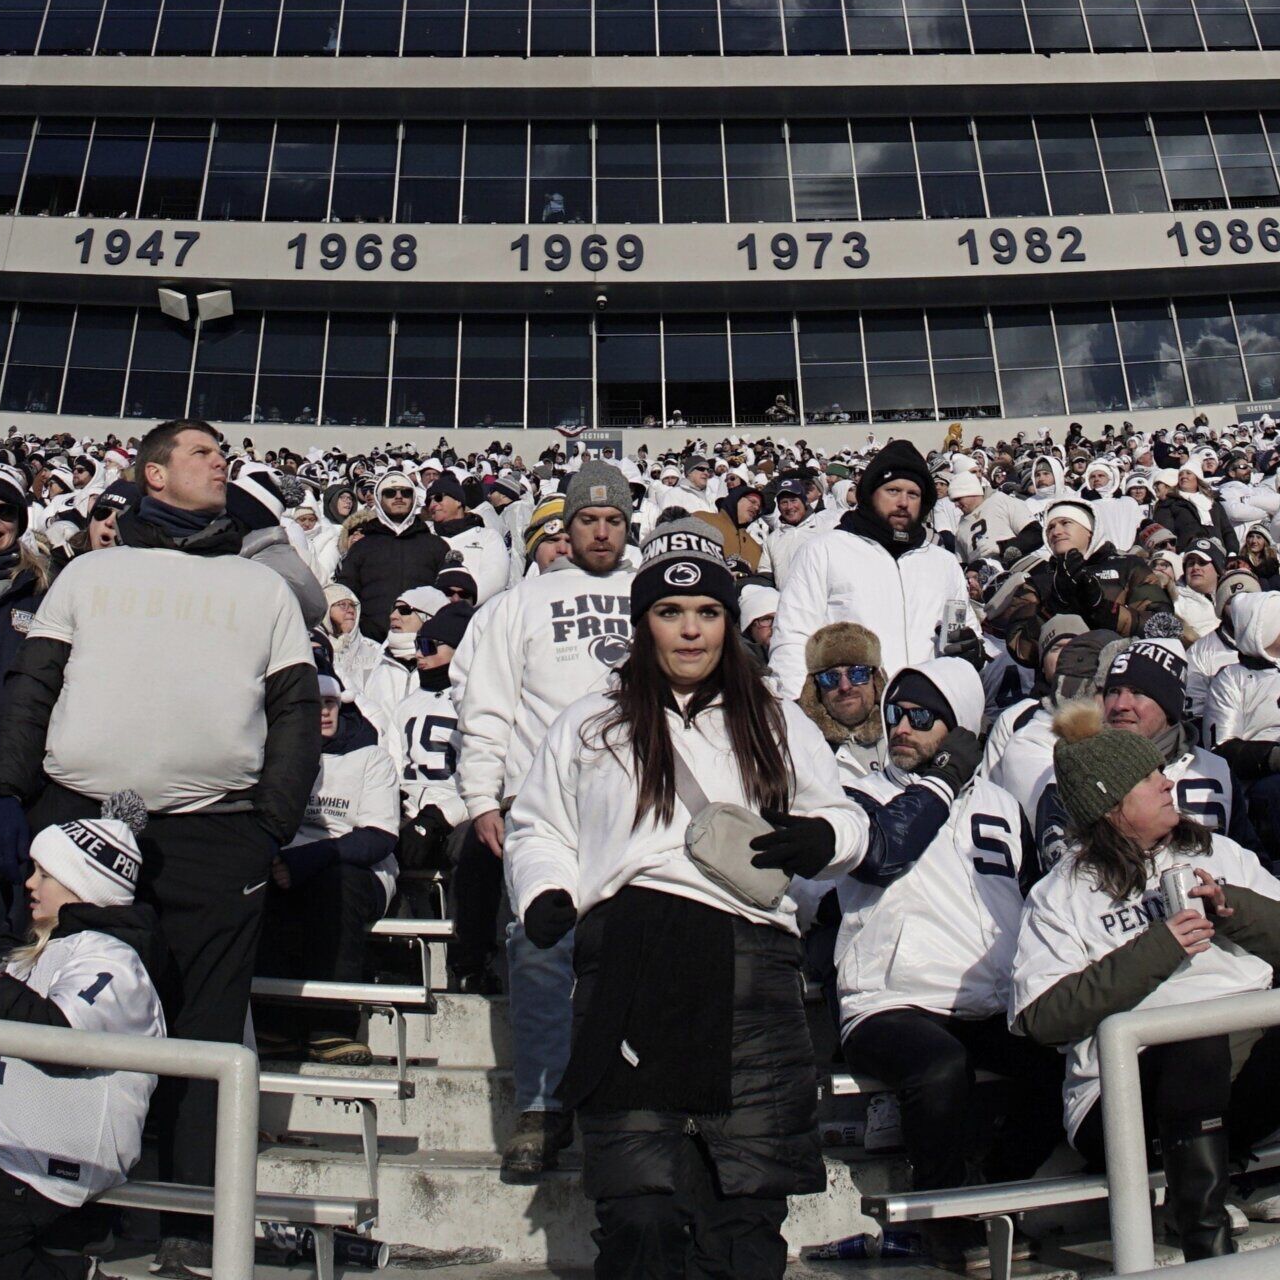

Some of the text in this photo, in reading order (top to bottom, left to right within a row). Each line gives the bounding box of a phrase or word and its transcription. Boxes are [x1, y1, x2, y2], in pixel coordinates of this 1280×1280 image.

[74, 227, 201, 268] 1947
[287, 232, 418, 272] 1968
[510, 233, 644, 273] 1969
[737, 231, 870, 271] 1973
[957, 225, 1087, 266] 1982
[1246, 404, 1273, 412] SECTION
[670, 533, 724, 560] STATE
[551, 616, 634, 643] FRO
[556, 645, 578, 655] HAPPY
[556, 653, 580, 663] VALLEY
[1110, 654, 1131, 675] S
[403, 714, 458, 781] 15
[318, 795, 350, 809] WHEN
[323, 809, 347, 818] COUNT
[970, 813, 1016, 878] S
[77, 971, 114, 1006] 1
